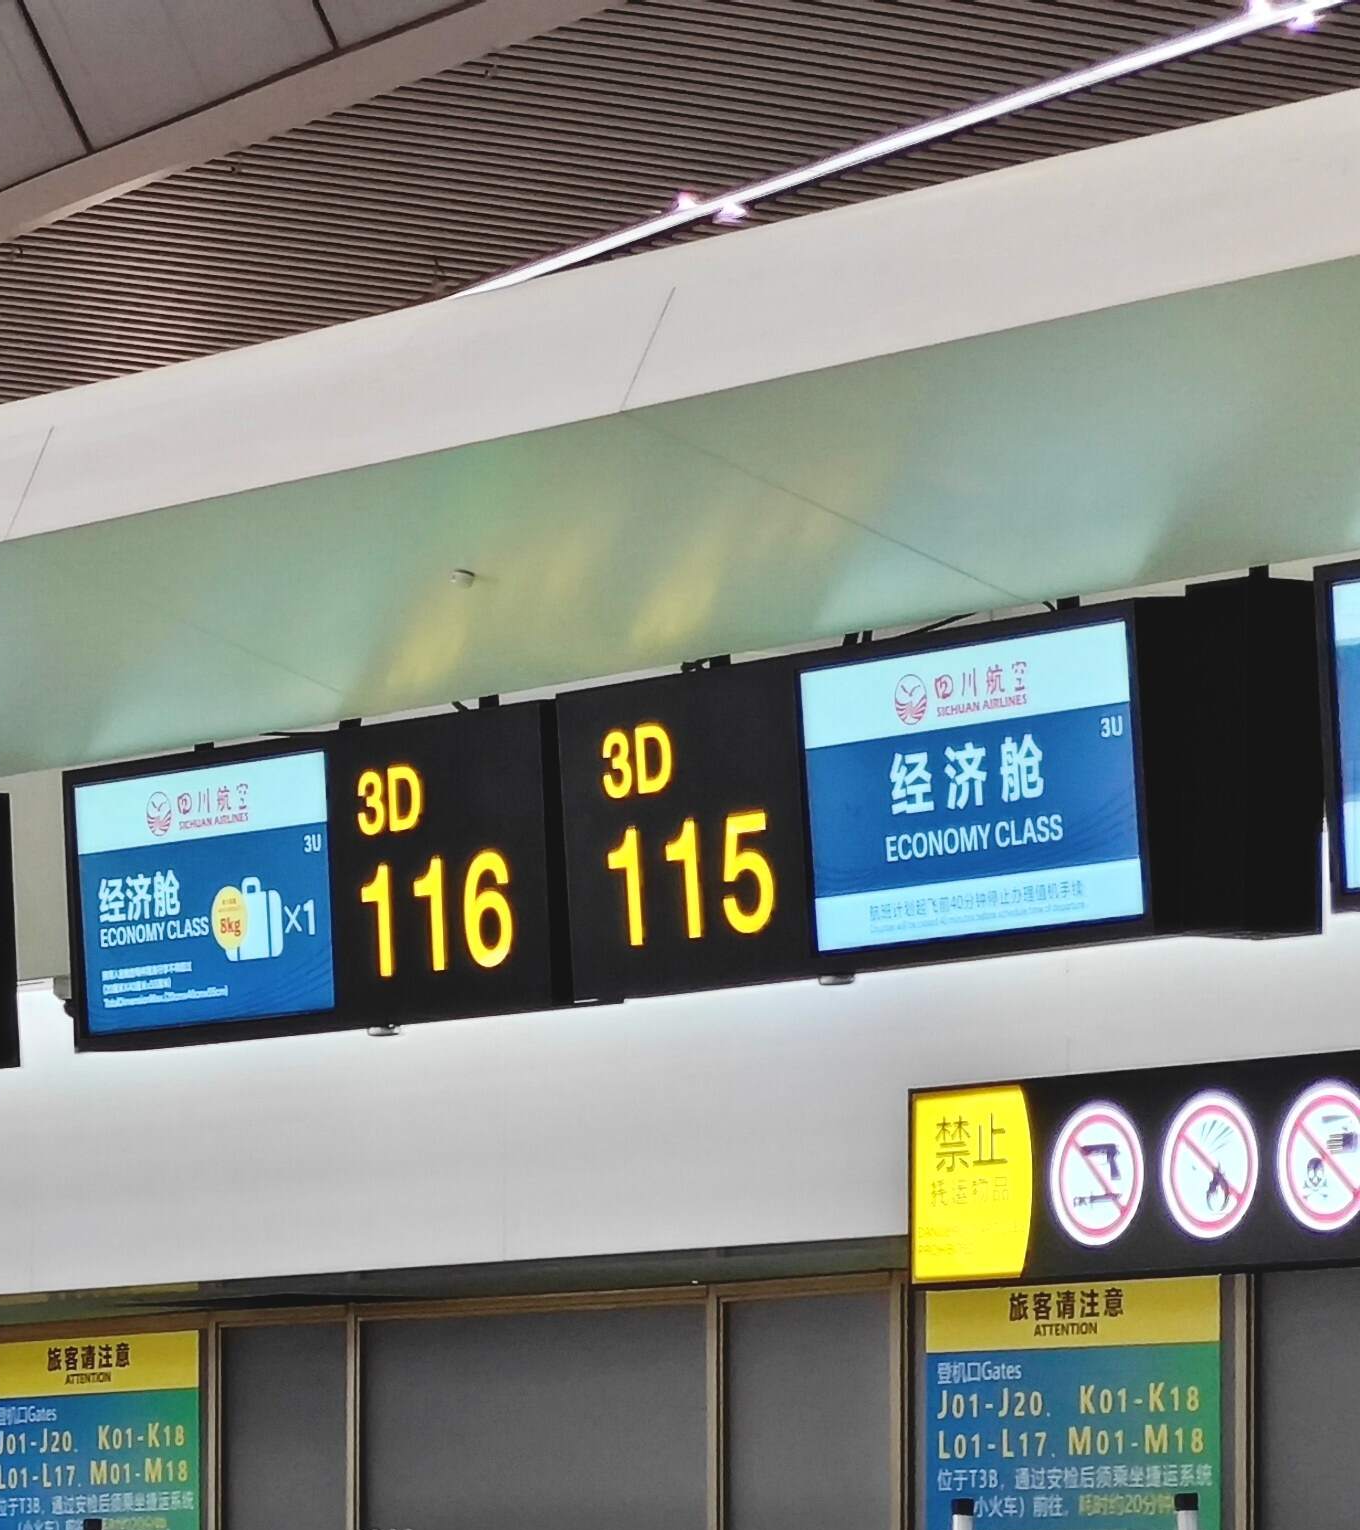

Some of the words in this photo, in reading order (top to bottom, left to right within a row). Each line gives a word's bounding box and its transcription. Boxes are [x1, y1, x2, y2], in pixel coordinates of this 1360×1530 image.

[935, 660, 1028, 700] 四川航空
[936, 702, 981, 718] SICHUAN
[982, 694, 1028, 712] AIRLINES
[1100, 715, 1123, 739] 3U
[601, 722, 673, 799] 3D
[890, 735, 1045, 816] 经济舱
[178, 783, 250, 815] 四川航空
[357, 765, 422, 837] 3D
[304, 834, 322, 854] 3U
[885, 823, 991, 863] ECONOMY
[994, 814, 1064, 848] CLASS
[607, 811, 776, 946] 115
[98, 870, 180, 924] 经济舱
[360, 850, 514, 978] 116
[100, 922, 165, 948] ECONOMY
[166, 916, 210, 941] CLASS
[936, 1112, 1008, 1172] 禁止
[1009, 1287, 1125, 1321] 旅客请注意
[1034, 1322, 1098, 1337] ATTENTION
[47, 1342, 131, 1372] 旅客请注意
[64, 1371, 111, 1385] ATTENTION
[1080, 1382, 1201, 1415] K01-K18
[98, 1422, 185, 1450] K01-K18
[1068, 1423, 1205, 1456] M01-M18
[90, 1457, 189, 1485] M01-M18
